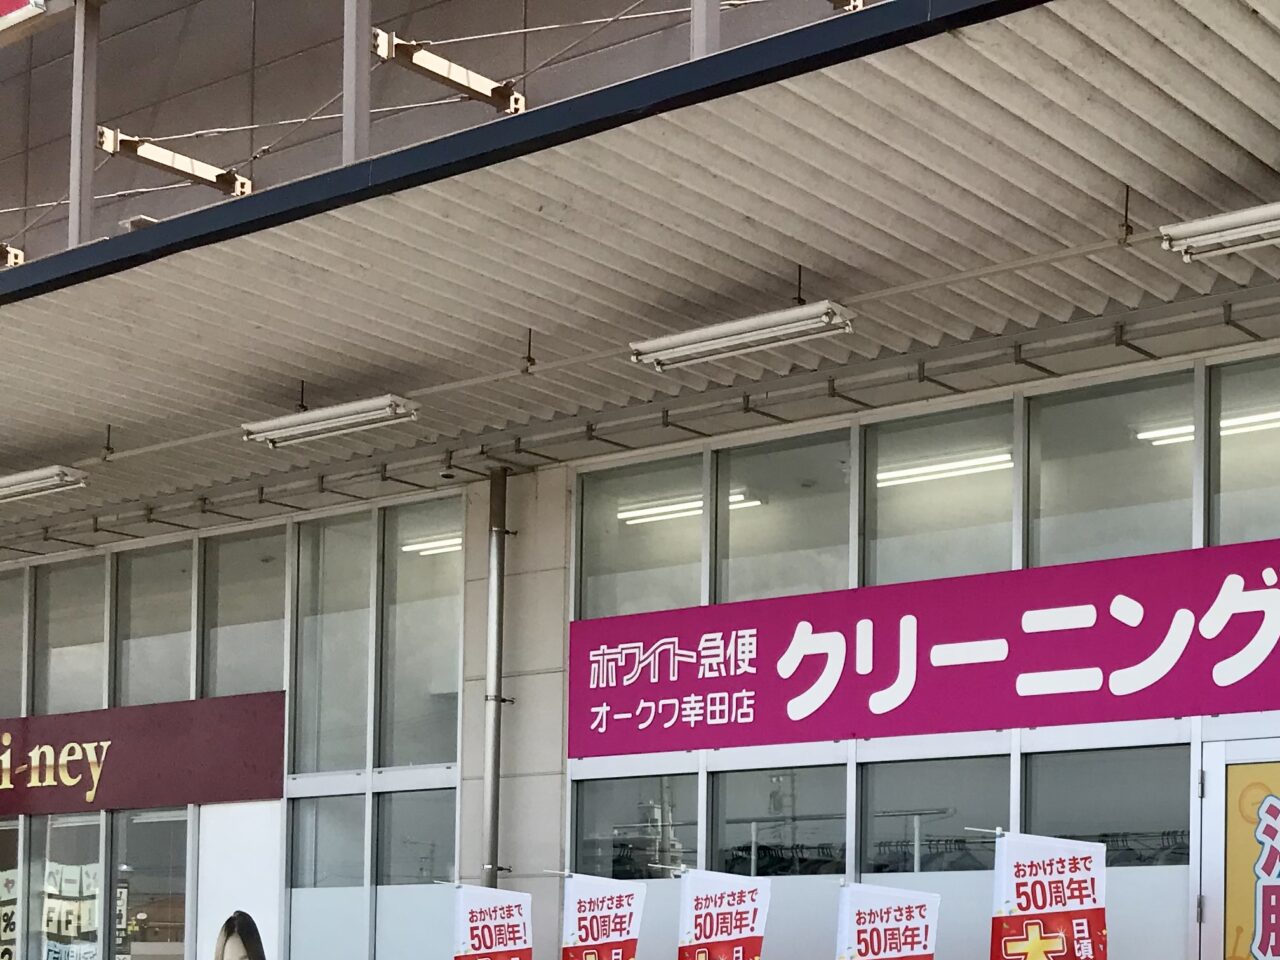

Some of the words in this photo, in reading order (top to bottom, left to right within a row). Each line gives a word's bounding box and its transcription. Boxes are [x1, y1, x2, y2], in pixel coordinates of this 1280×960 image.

[589, 628, 757, 689] ホワイト急便
[590, 689, 756, 733] オークワ幸田店
[1014, 856, 1093, 878] おかげさまで
[577, 893, 635, 913] おかげさまで
[693, 888, 759, 911] おかげさまで
[1015, 877, 1097, 911] 50周年!
[469, 904, 523, 924] おかげさまで
[578, 911, 634, 943] 50周年!
[693, 907, 758, 942] 50周年!
[855, 903, 928, 926] おかげさまで
[470, 921, 528, 951] 50周年!
[857, 925, 929, 957] 50周年!
